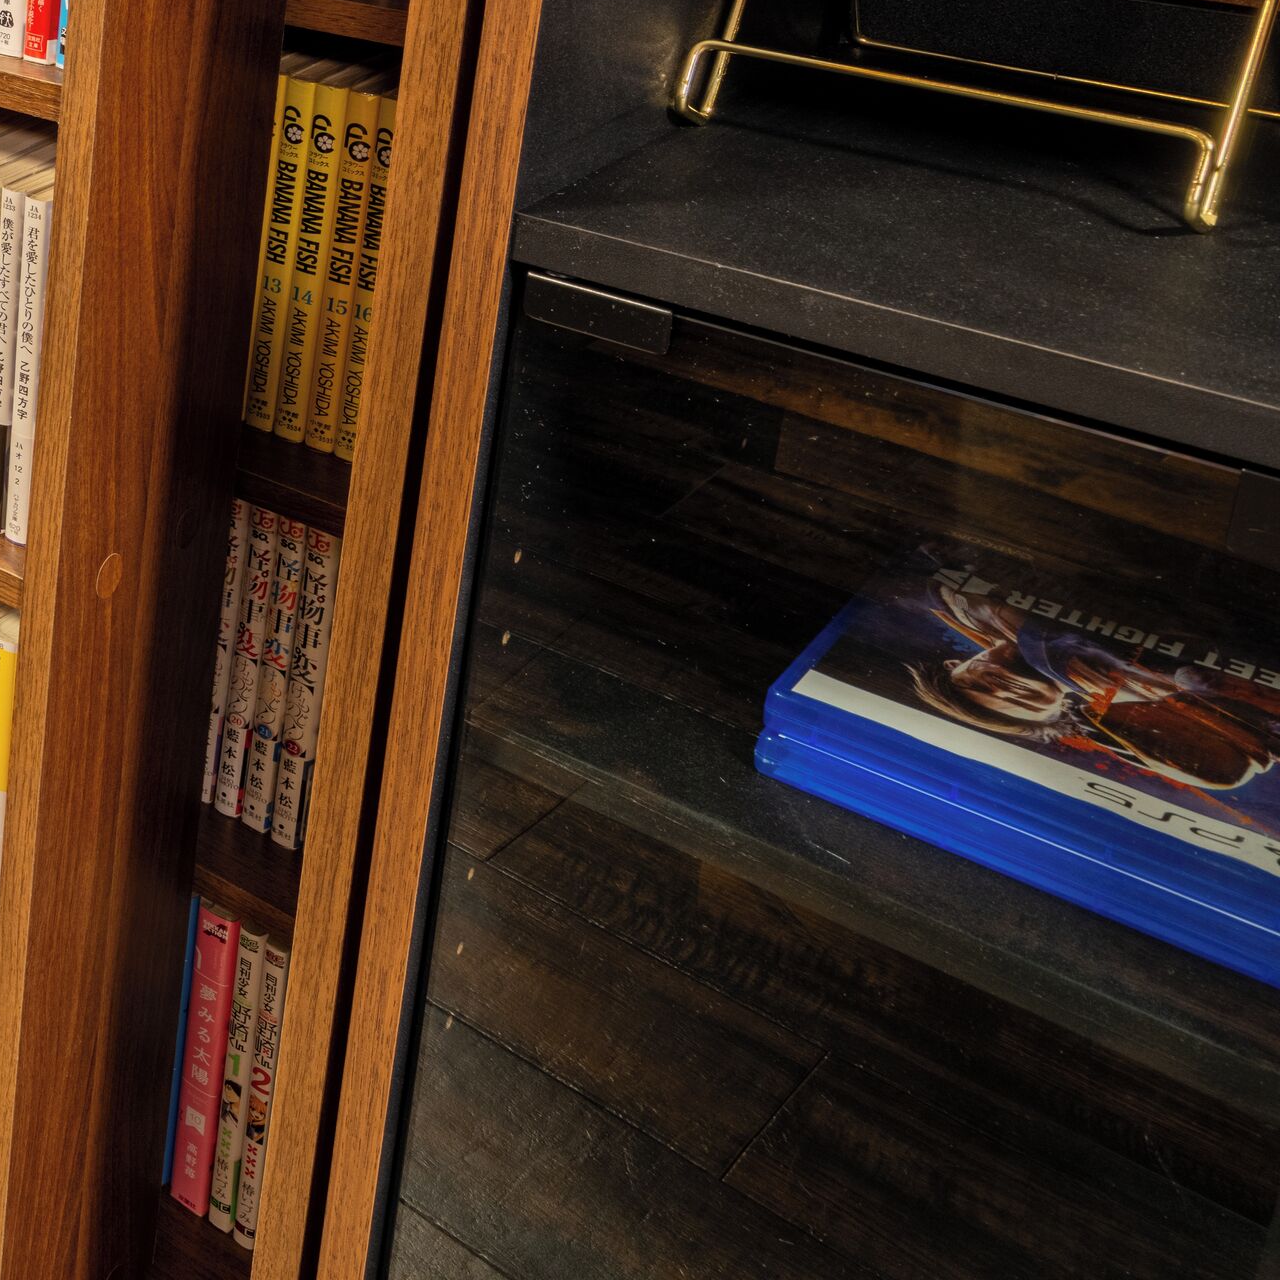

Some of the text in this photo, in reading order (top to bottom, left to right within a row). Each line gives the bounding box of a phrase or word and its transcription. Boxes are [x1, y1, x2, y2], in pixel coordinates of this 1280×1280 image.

[266, 159, 298, 265] BANANA FISH
[295, 168, 329, 276] BANANA FISH
[328, 178, 364, 286] BANANA FISH
[357, 183, 387, 292] BANANA FISH
[17, 227, 40, 420] 君を愛したひとりの僕へ 乙野四方字
[262, 276, 282, 294] 13
[292, 287, 313, 306] 14
[326, 298, 348, 315] 15
[252, 296, 277, 394] AKIMI YOSHIDA
[283, 307, 308, 406] AKIMI YOSHIDA
[315, 318, 341, 417] AKIMI YOSHIDA
[342, 324, 368, 425] AKIMI YOSHIDA
[291, 567, 328, 684] 怪物事変
[1005, 589, 1186, 659] FIGHTER
[221, 728, 240, 779] 藍本松
[249, 740, 268, 791] 藍本松
[278, 758, 297, 810] 藍本松
[190, 983, 218, 1087] 夢みる太陽
[229, 957, 252, 1054] 月刊少女 野崎くん
[254, 972, 278, 1070] 月刊少女 野崎くん
[228, 1053, 241, 1077] 1
[251, 1066, 272, 1096] 2
[215, 1155, 229, 1200] 椿いづみ
[239, 1180, 255, 1224] 椿いづみ
